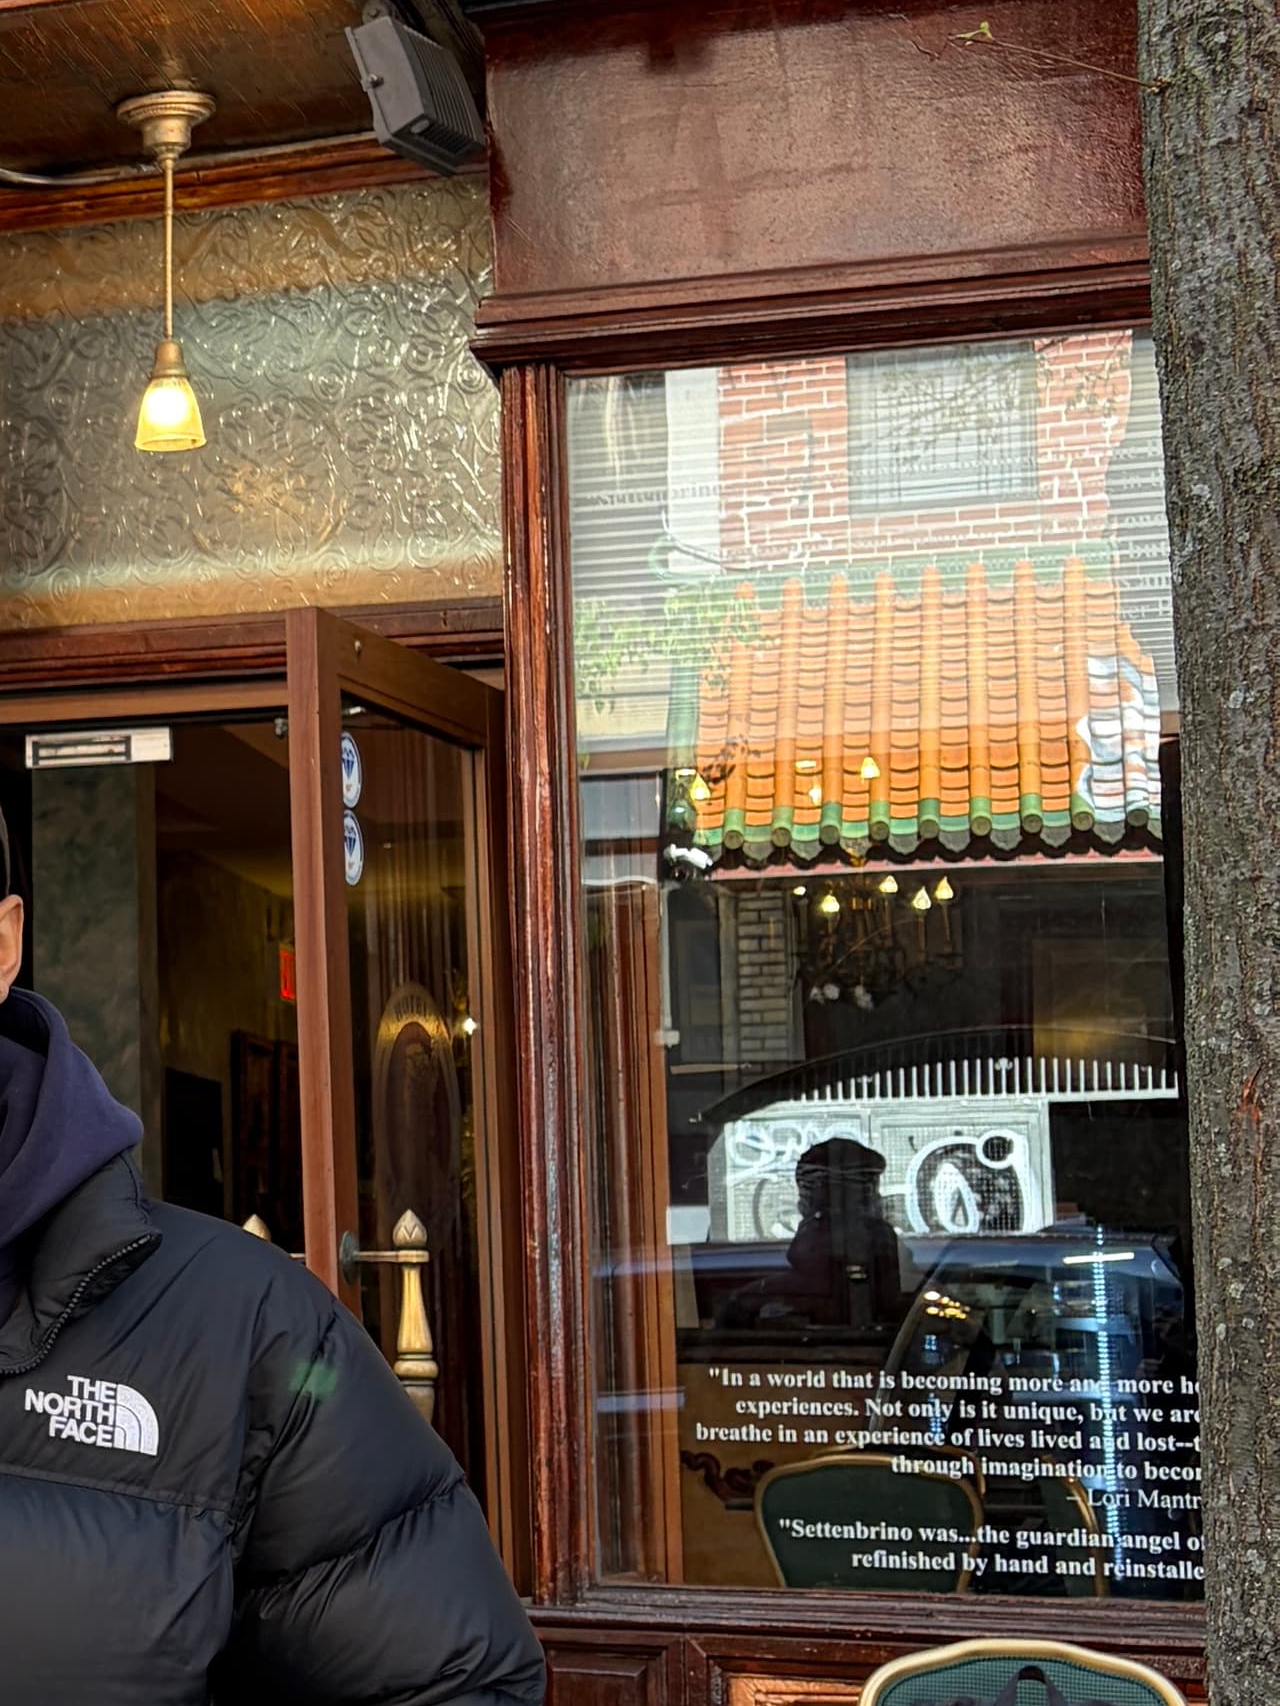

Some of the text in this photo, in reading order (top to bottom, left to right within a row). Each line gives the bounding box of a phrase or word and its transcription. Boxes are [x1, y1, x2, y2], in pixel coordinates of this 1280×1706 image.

[67, 1375, 118, 1404] THE
[749, 1372, 761, 1388] a
[767, 1368, 825, 1389] world
[832, 1369, 873, 1389] that
[879, 1370, 895, 1390] is
[901, 1370, 1002, 1395] becoming
[1009, 1377, 1063, 1392] more
[1117, 1377, 1174, 1394] more
[24, 1388, 114, 1426] NORTH
[736, 1397, 1164, 1425] experiences. Not only is it unique, but we
[49, 1415, 114, 1448] FACE
[696, 1422, 772, 1443] breathe
[778, 1424, 798, 1443] in
[804, 1429, 828, 1444] an
[835, 1426, 945, 1449] experience
[951, 1427, 973, 1446] of
[977, 1428, 1025, 1448] lives
[1031, 1429, 1082, 1449] lived
[891, 1454, 974, 1479] through
[981, 1457, 1108, 1481] imagination
[1117, 1460, 1137, 1480] to
[1088, 1490, 1130, 1509] Lori
[1016, 1527, 1114, 1550] guardian
[1120, 1530, 1181, 1553] angel
[852, 1549, 1204, 1580] refinished by hand and reinstalle
